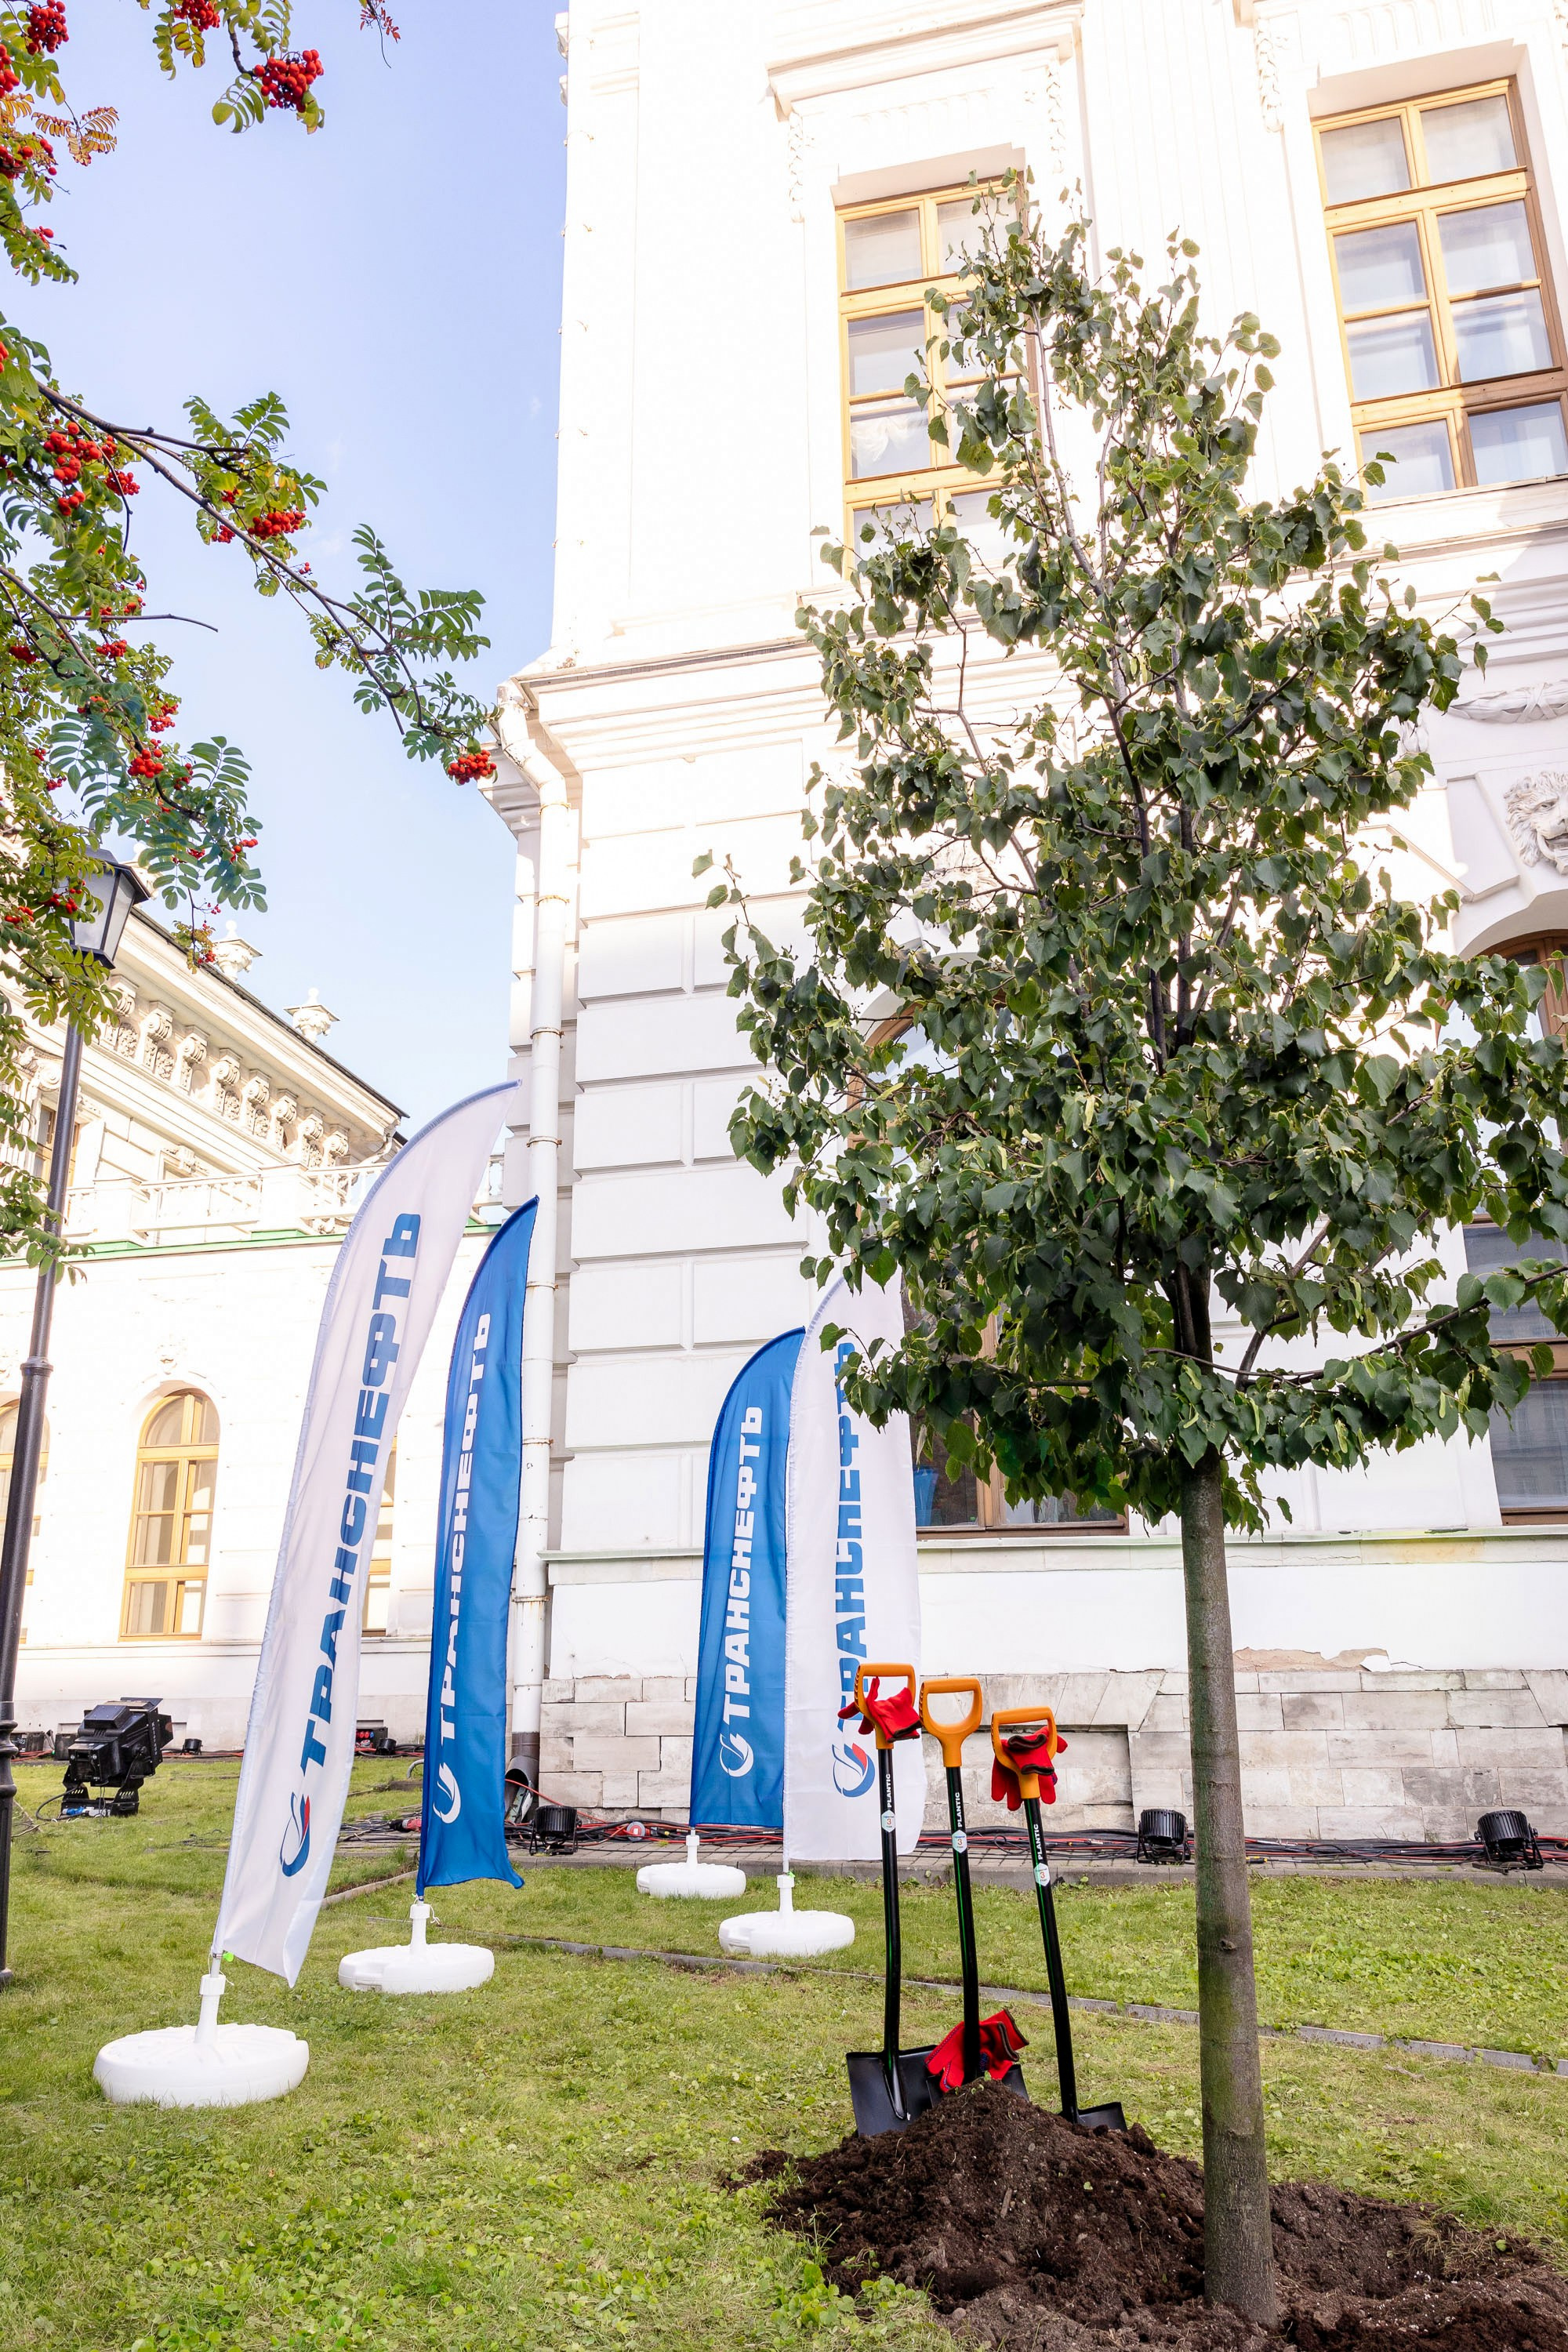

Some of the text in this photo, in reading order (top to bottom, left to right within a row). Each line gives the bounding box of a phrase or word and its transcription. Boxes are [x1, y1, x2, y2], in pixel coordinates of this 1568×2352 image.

[299, 1213, 421, 1777] ТРАНСНЕФТЬ
[440, 1312, 491, 1747] ТРАНСНЕФТЬ
[723, 1406, 763, 1726] ТРАНСНЕФТЬ
[1033, 1824, 1044, 1860] PLANTIC
